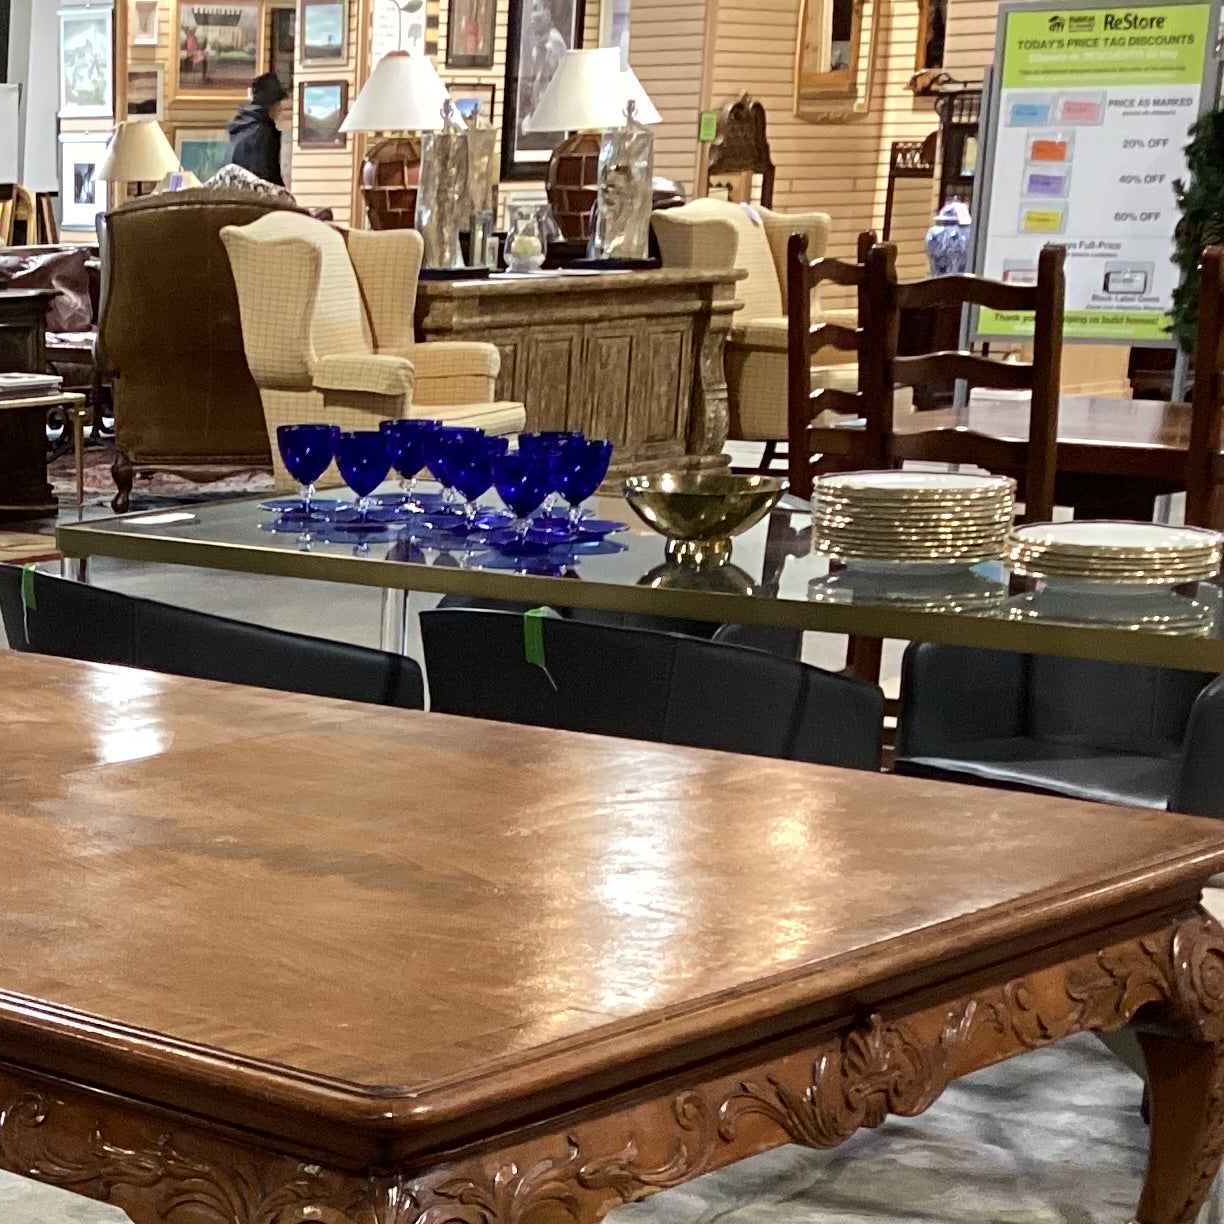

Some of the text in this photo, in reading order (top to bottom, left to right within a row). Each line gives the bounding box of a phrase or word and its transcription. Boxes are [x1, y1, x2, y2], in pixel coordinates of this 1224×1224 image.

[1104, 12, 1166, 31] ReStore
[1018, 34, 1195, 50] TODAY'S PRICE TAG DISCOUNTS
[1108, 97, 1193, 107] PRICE AS MARKED
[1122, 138, 1169, 149] 20% OFF
[1119, 174, 1166, 184] 40% OFF
[1139, 212, 1161, 221] OFF
